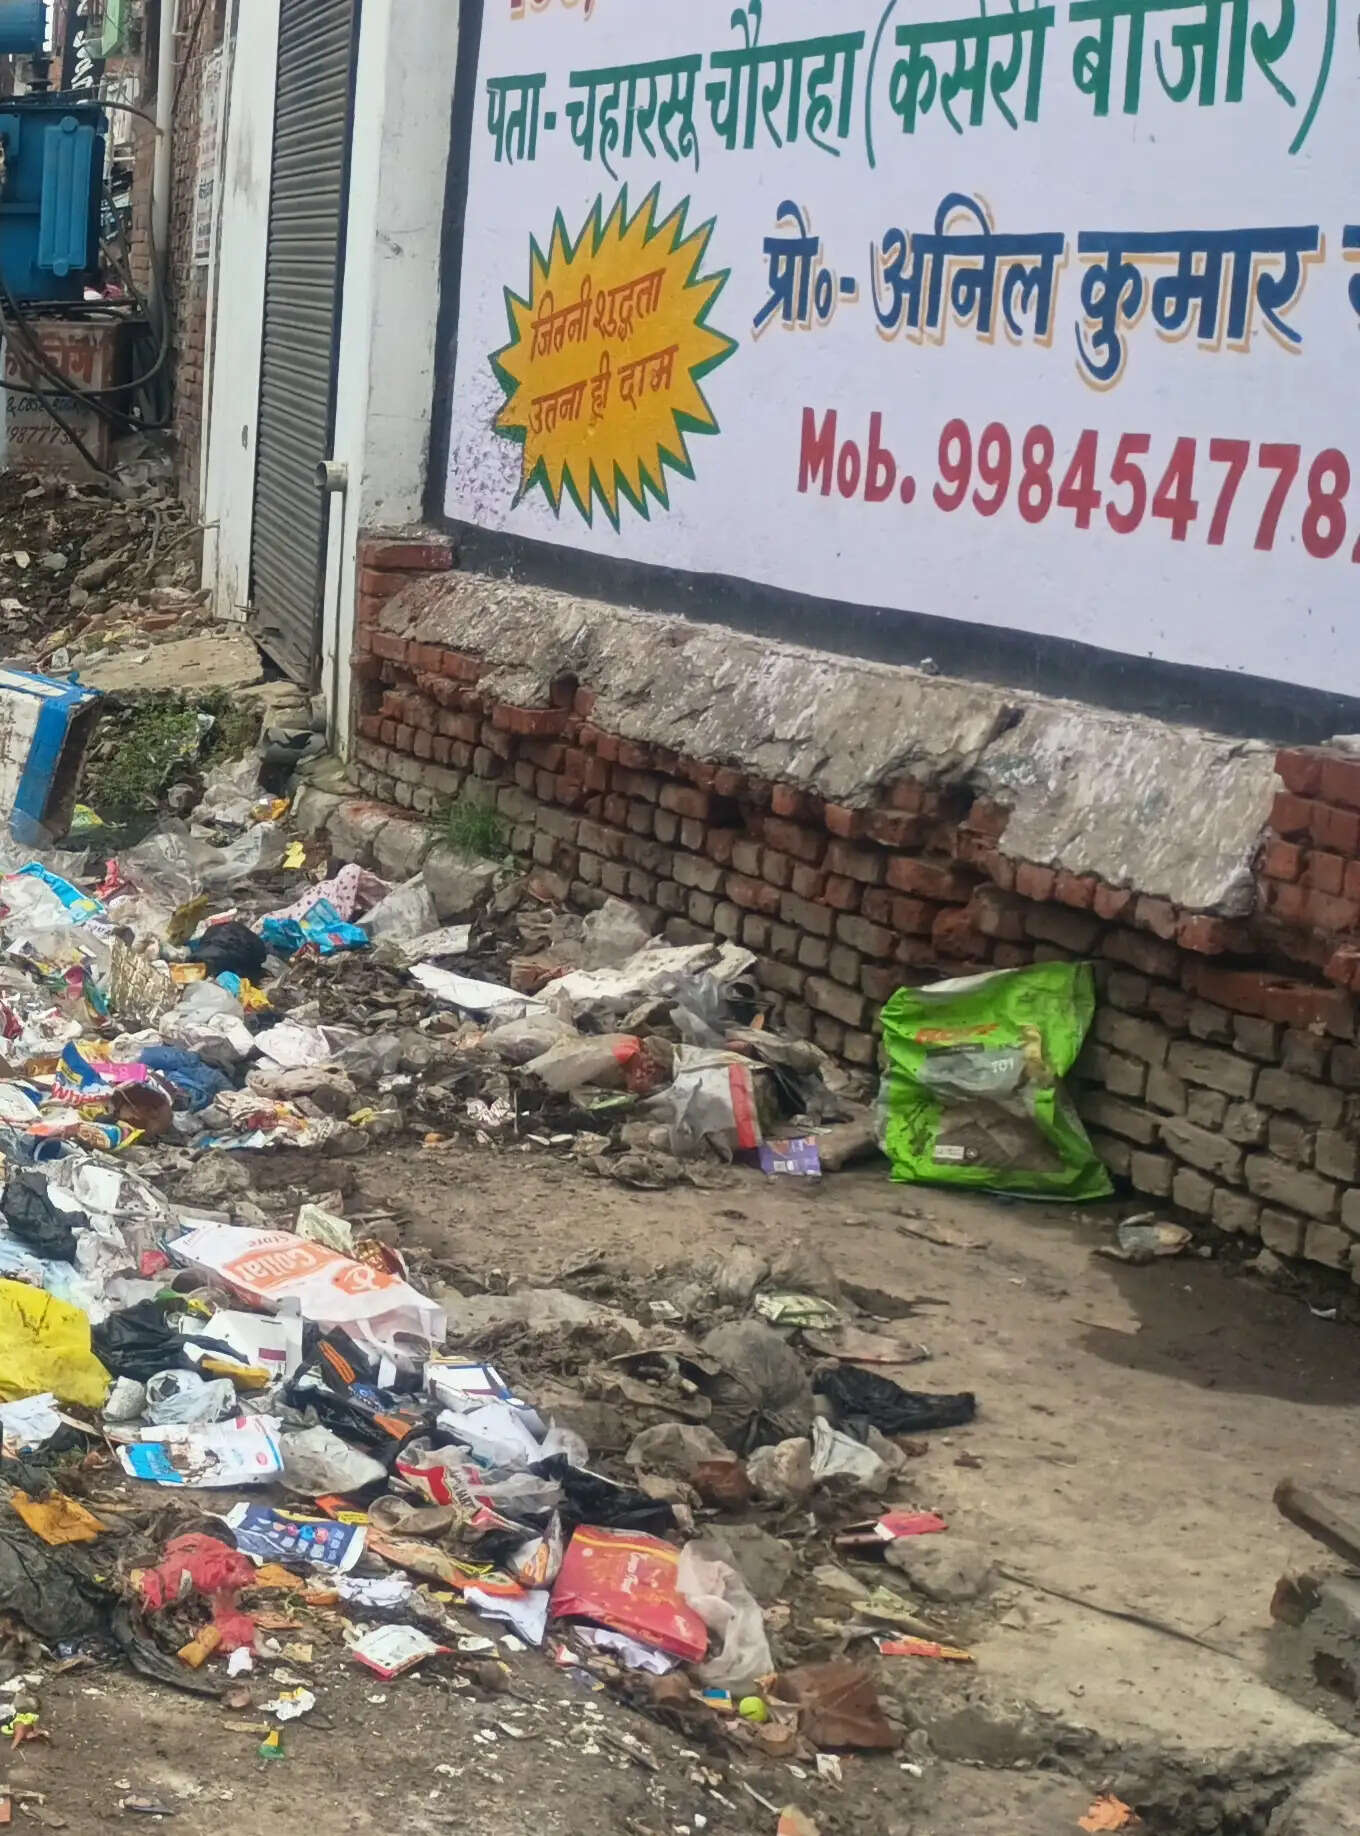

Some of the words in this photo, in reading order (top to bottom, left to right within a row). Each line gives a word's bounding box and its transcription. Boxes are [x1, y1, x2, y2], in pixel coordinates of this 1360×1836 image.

[705, 0, 865, 157] चौराहा
[530, 274, 593, 361] जितनी
[868, 193, 1070, 345] अनिल
[1075, 225, 1326, 390] कुमार
[528, 380, 587, 434] उतना
[590, 350, 611, 420] ही
[617, 344, 680, 410] दाम
[797, 407, 916, 504] Mob.
[933, 417, 1360, 563] 998454778
[248, 1234, 290, 1248] Store
